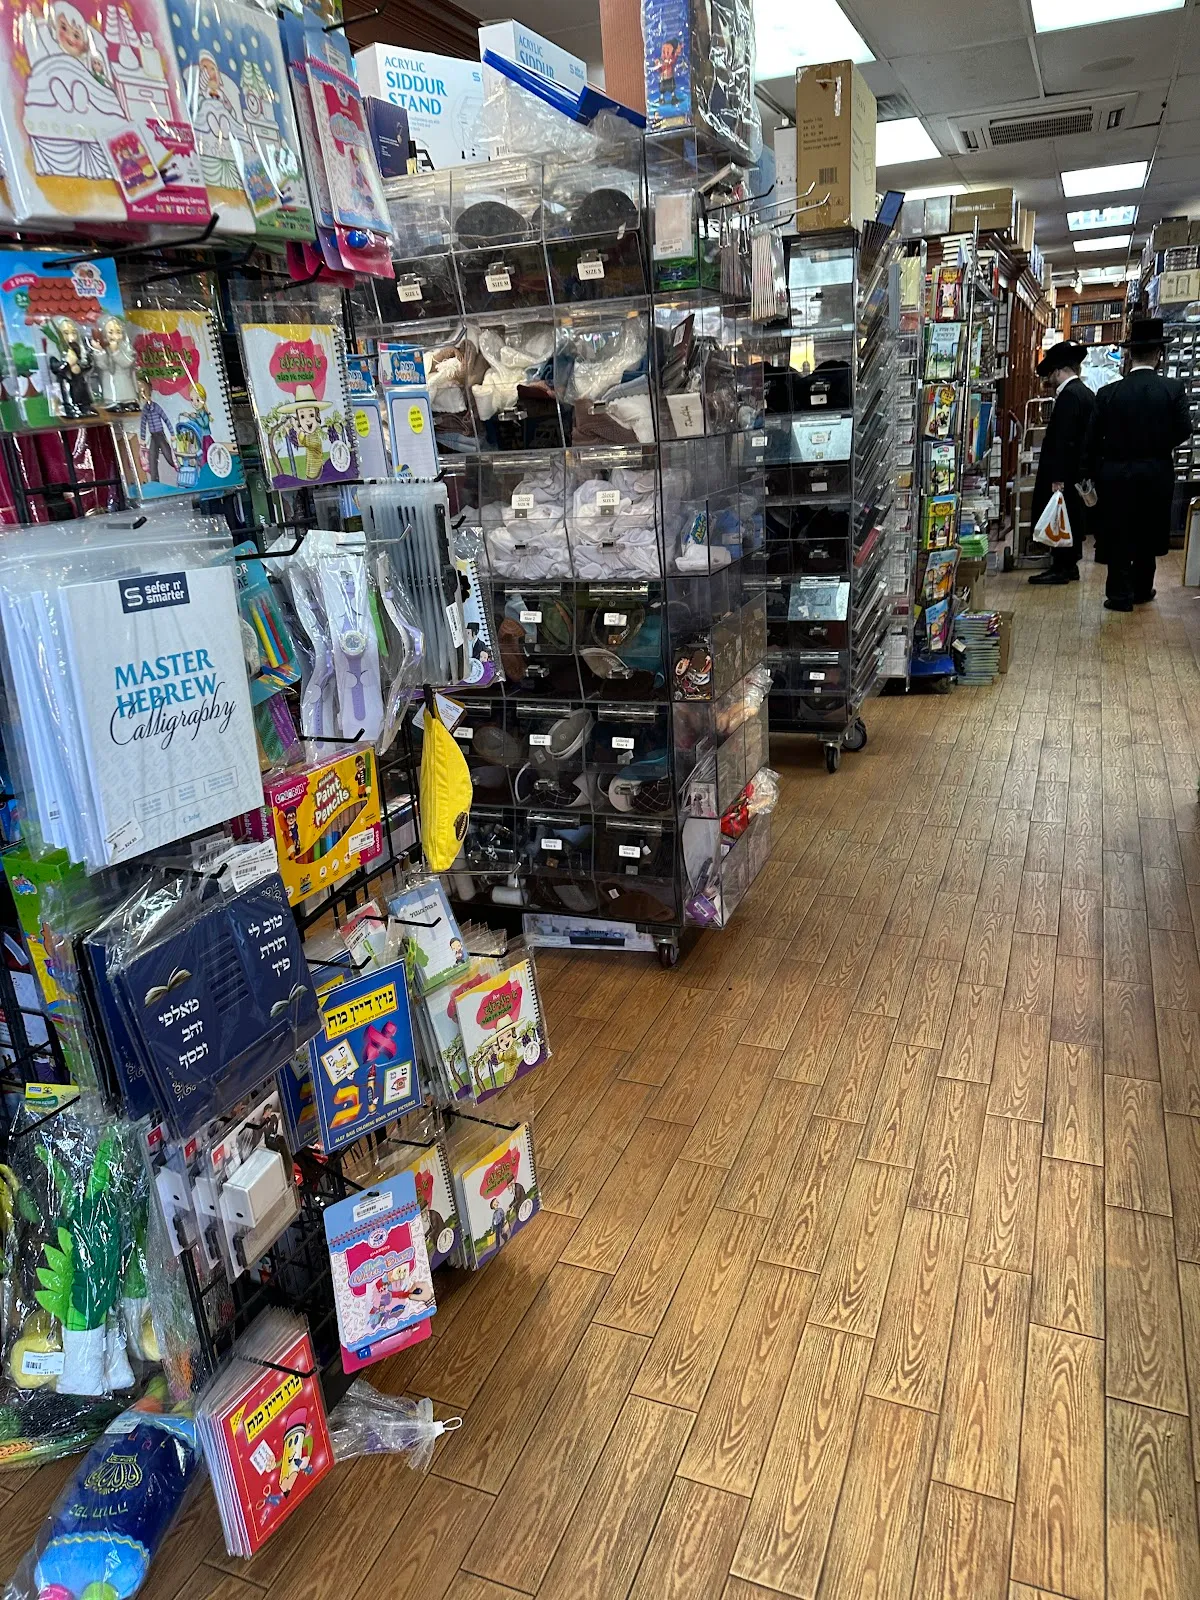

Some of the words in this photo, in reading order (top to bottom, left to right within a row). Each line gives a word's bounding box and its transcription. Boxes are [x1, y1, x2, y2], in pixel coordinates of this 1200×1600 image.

[519, 35, 544, 58] ACRYLIC
[384, 56, 426, 74] ACRYLIC
[519, 50, 555, 79] SIDDUR
[386, 71, 448, 98] SIDDUR
[388, 91, 442, 116] STAND
[16, 276, 36, 287] PACK
[144, 580, 171, 595] sefer
[145, 590, 185, 604] smarter
[114, 648, 215, 690] MASTER
[116, 672, 217, 718] HEBREW
[110, 681, 236, 750] Calligraphy
[315, 777, 342, 807] Paint
[314, 788, 350, 826] Pencils
[248, 923, 261, 938] לי
[262, 914, 283, 934] טוב
[259, 935, 288, 960] תורת
[271, 956, 291, 978] פיך
[158, 998, 200, 1028] מאלפי
[349, 999, 373, 1023] דיין
[181, 1019, 204, 1043] זהב
[178, 1041, 209, 1071] וכסף
[334, 1134, 346, 1144] ALEF
[355, 1120, 376, 1134] COLORING
[375, 1113, 387, 1123] BOOK
[387, 1108, 398, 1118] WITH
[397, 1099, 416, 1112] PICTURES
[264, 1390, 284, 1419] דיין
[92, 1501, 129, 1519] תורה
